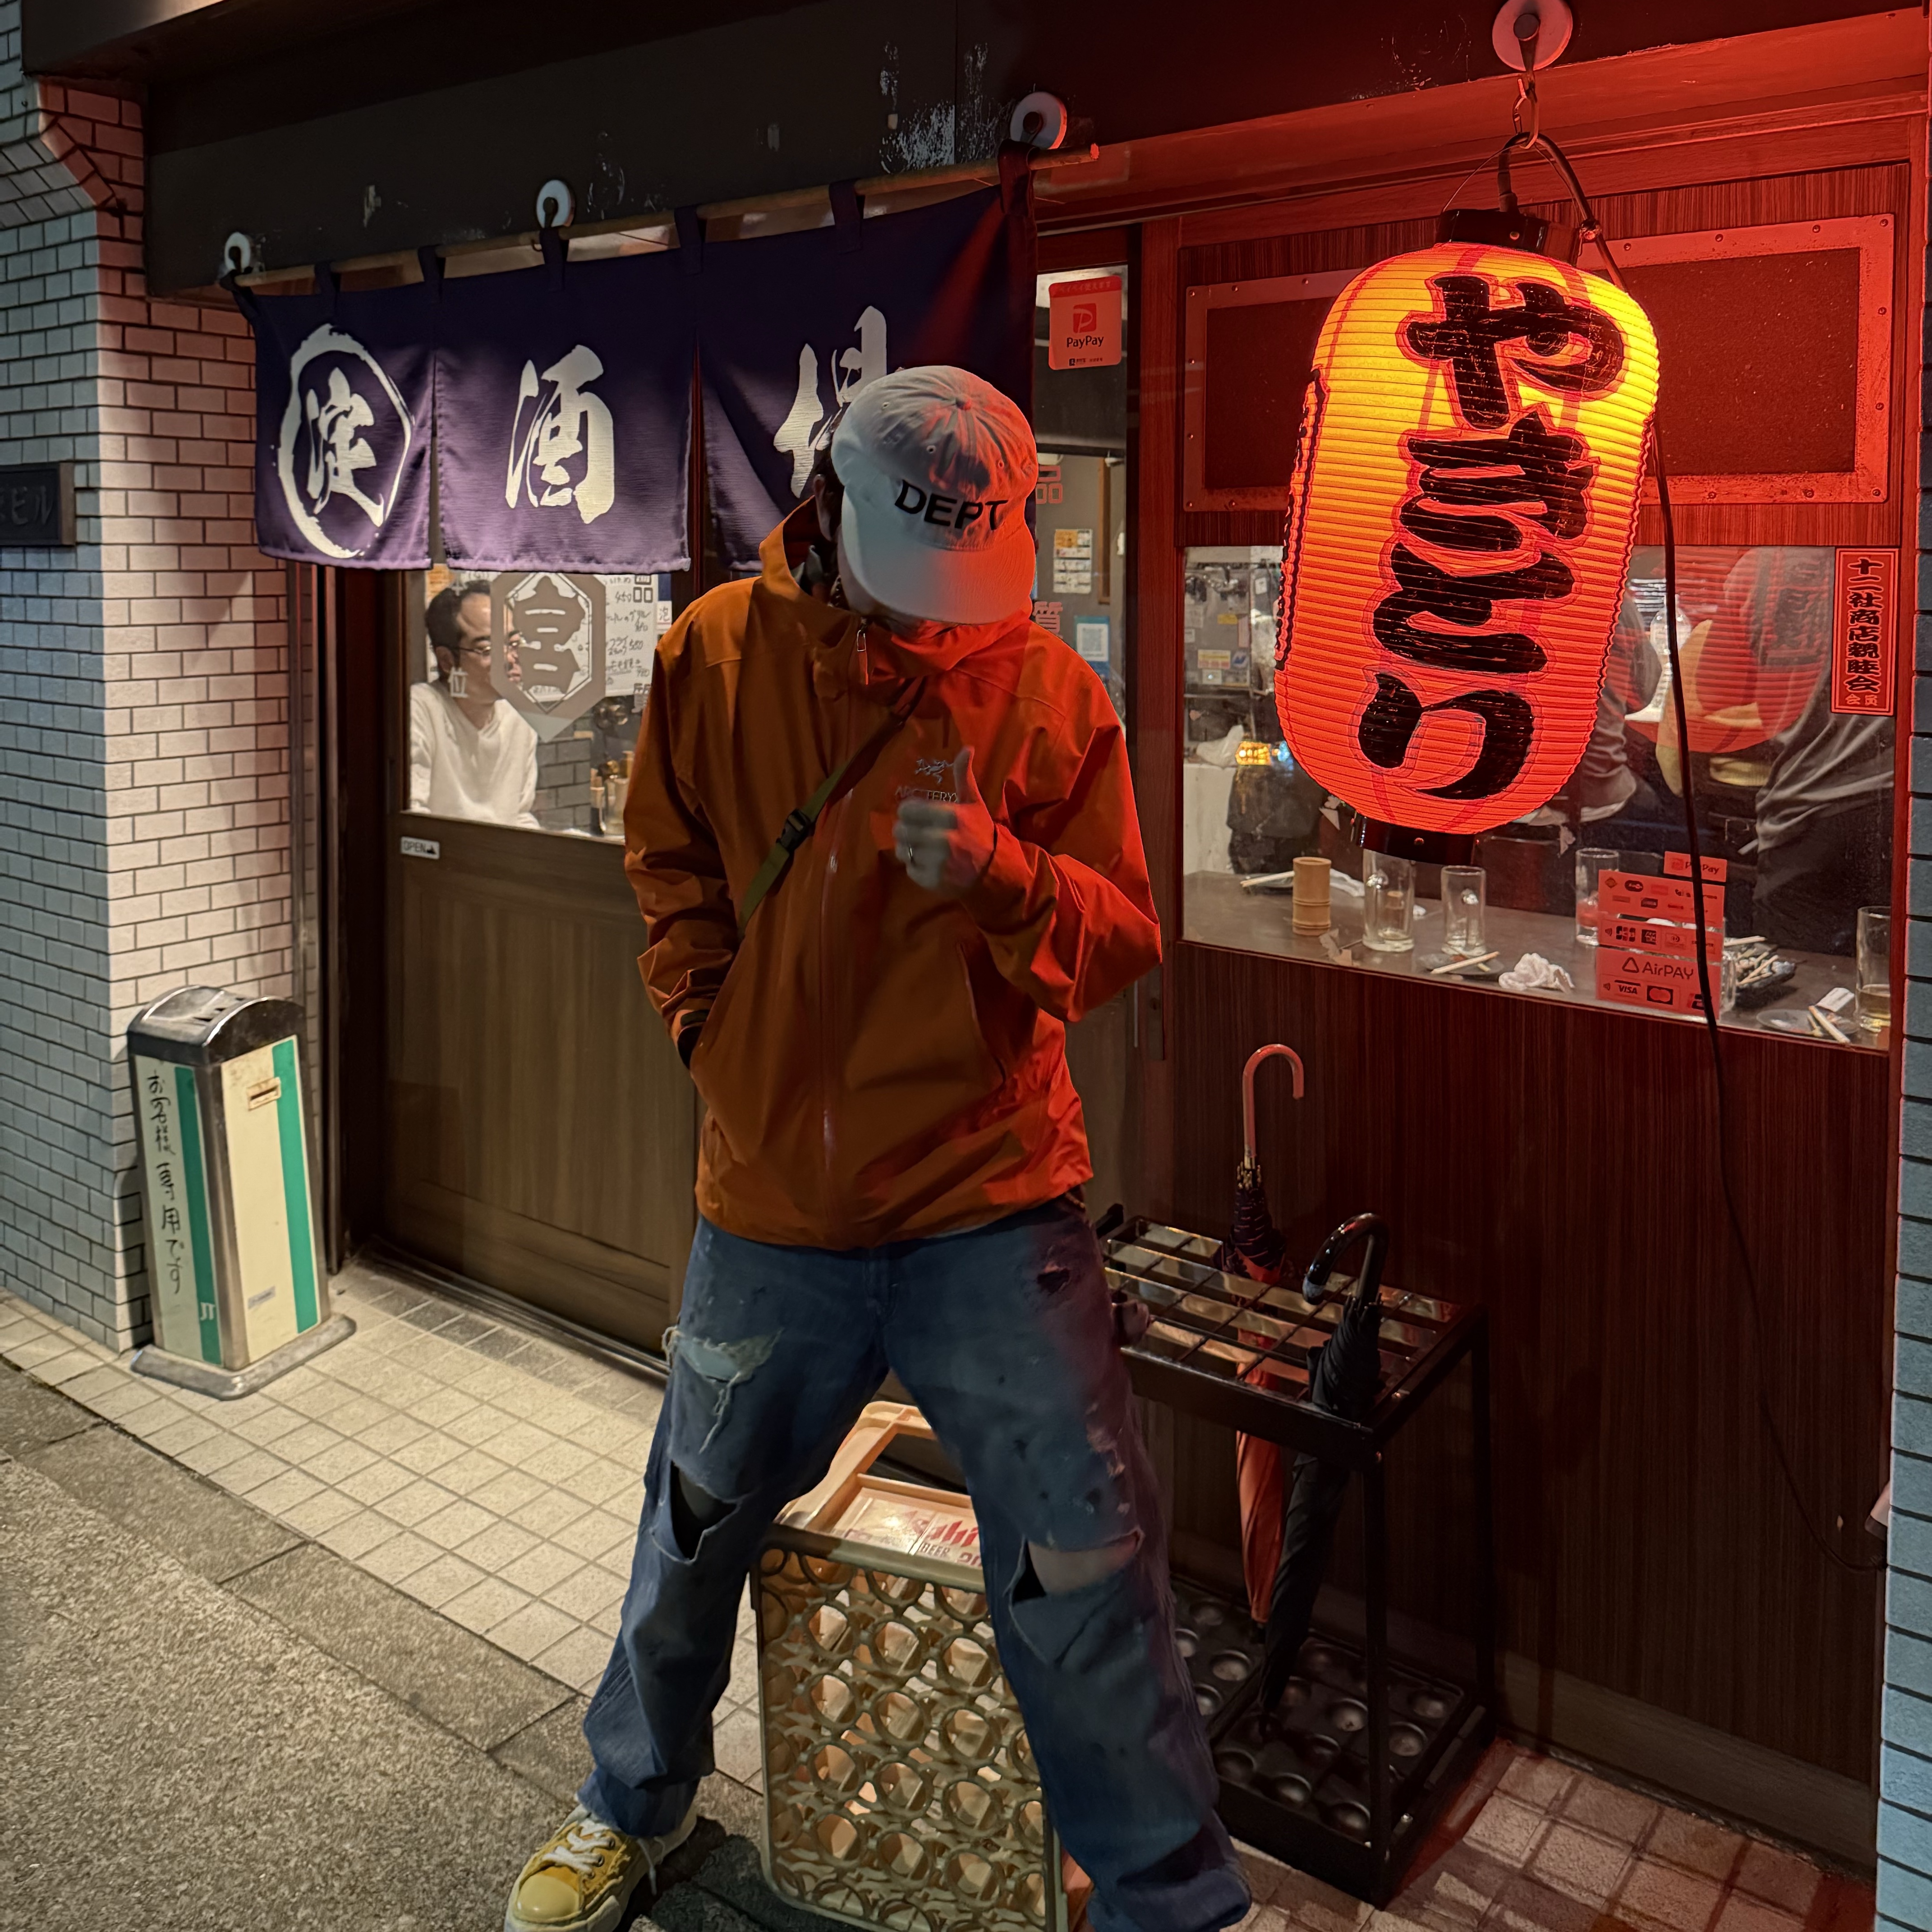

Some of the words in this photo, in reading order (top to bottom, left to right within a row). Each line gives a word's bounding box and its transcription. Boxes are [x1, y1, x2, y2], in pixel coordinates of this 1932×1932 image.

[1066, 335, 1104, 349] PayPay
[0, 485, 54, 525] ビル
[895, 479, 1008, 530] DEPT
[1846, 558, 1884, 693] 十二社商店親睦会
[1845, 694, 1878, 706] 会員
[1685, 861, 1720, 875] PPay
[1642, 961, 1693, 980] AirPAY
[1619, 984, 1638, 994] VISA
[147, 1069, 185, 1295] お客様専用です
[200, 1302, 216, 1321] JT
[921, 1542, 951, 1558] BEER
